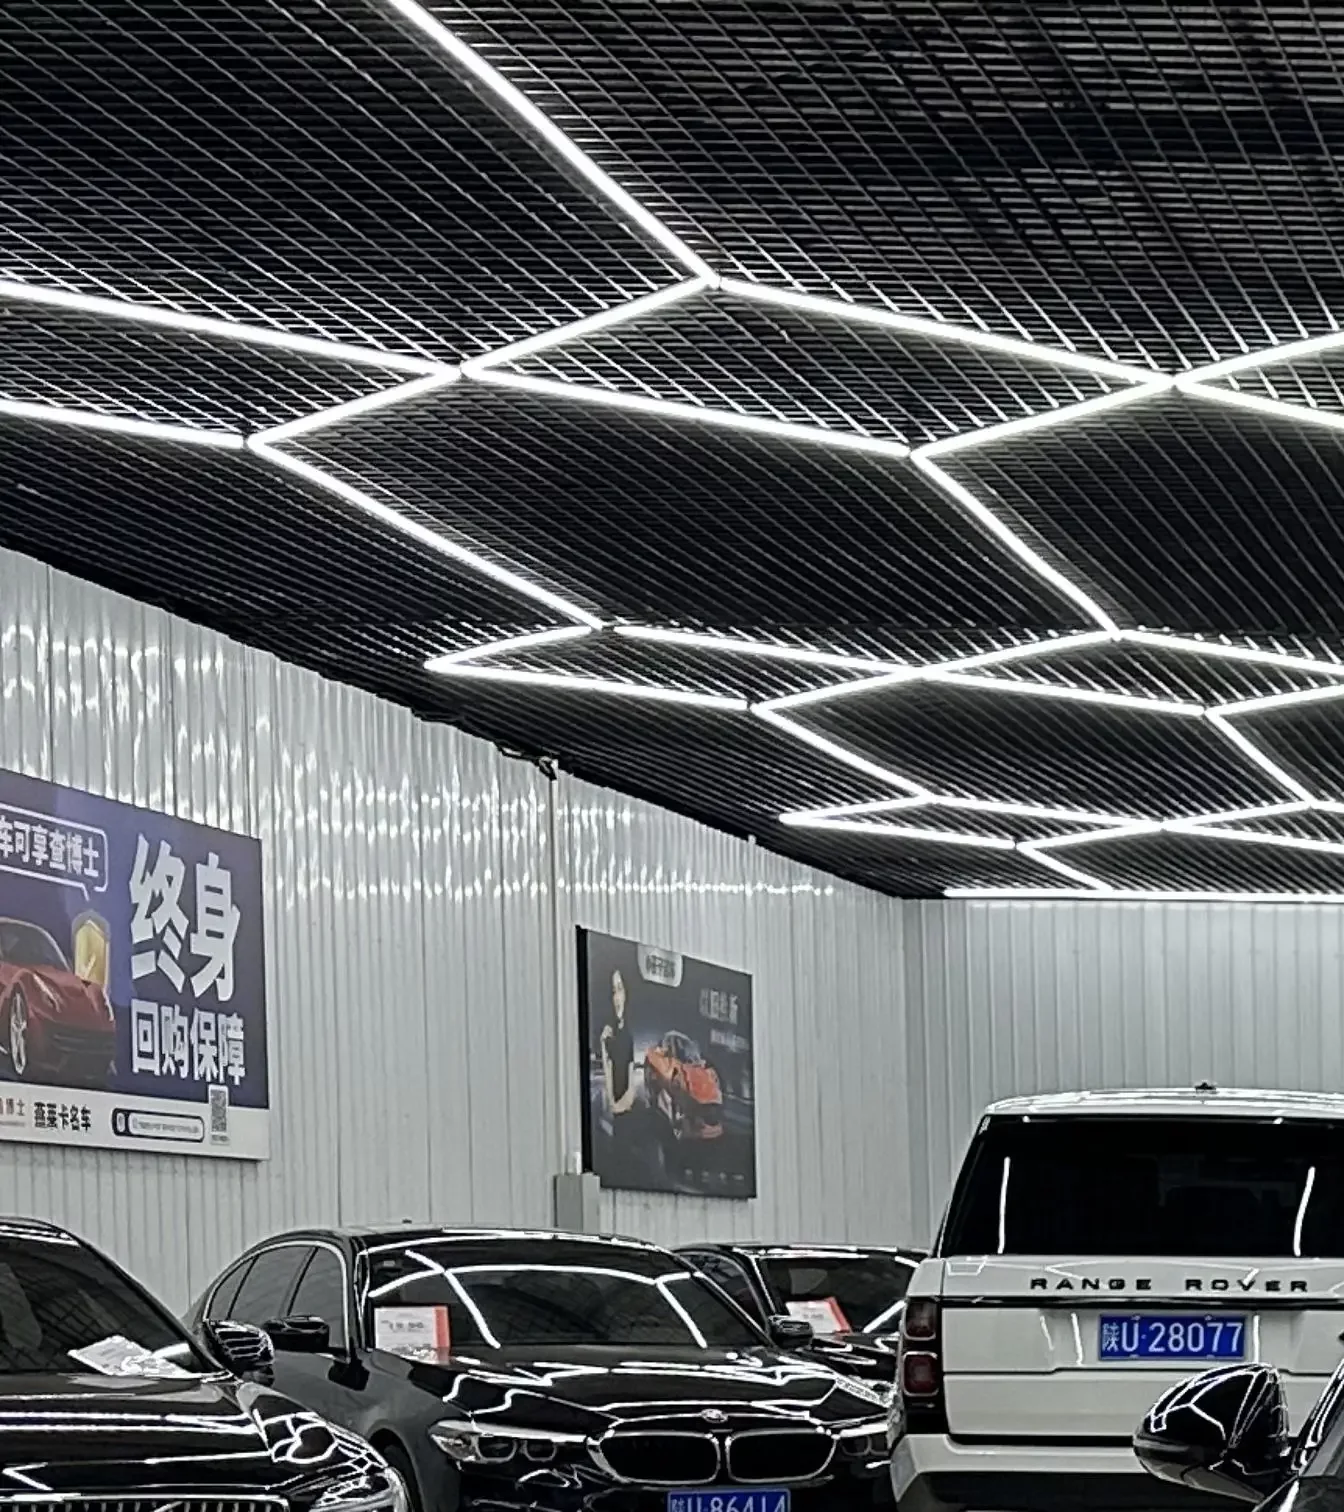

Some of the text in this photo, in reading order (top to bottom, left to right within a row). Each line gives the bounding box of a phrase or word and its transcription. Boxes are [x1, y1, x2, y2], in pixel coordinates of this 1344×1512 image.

[129, 833, 241, 1001] 终身
[131, 998, 246, 1086] 回购保障
[1030, 1278, 1308, 1293] RANGE ROVER
